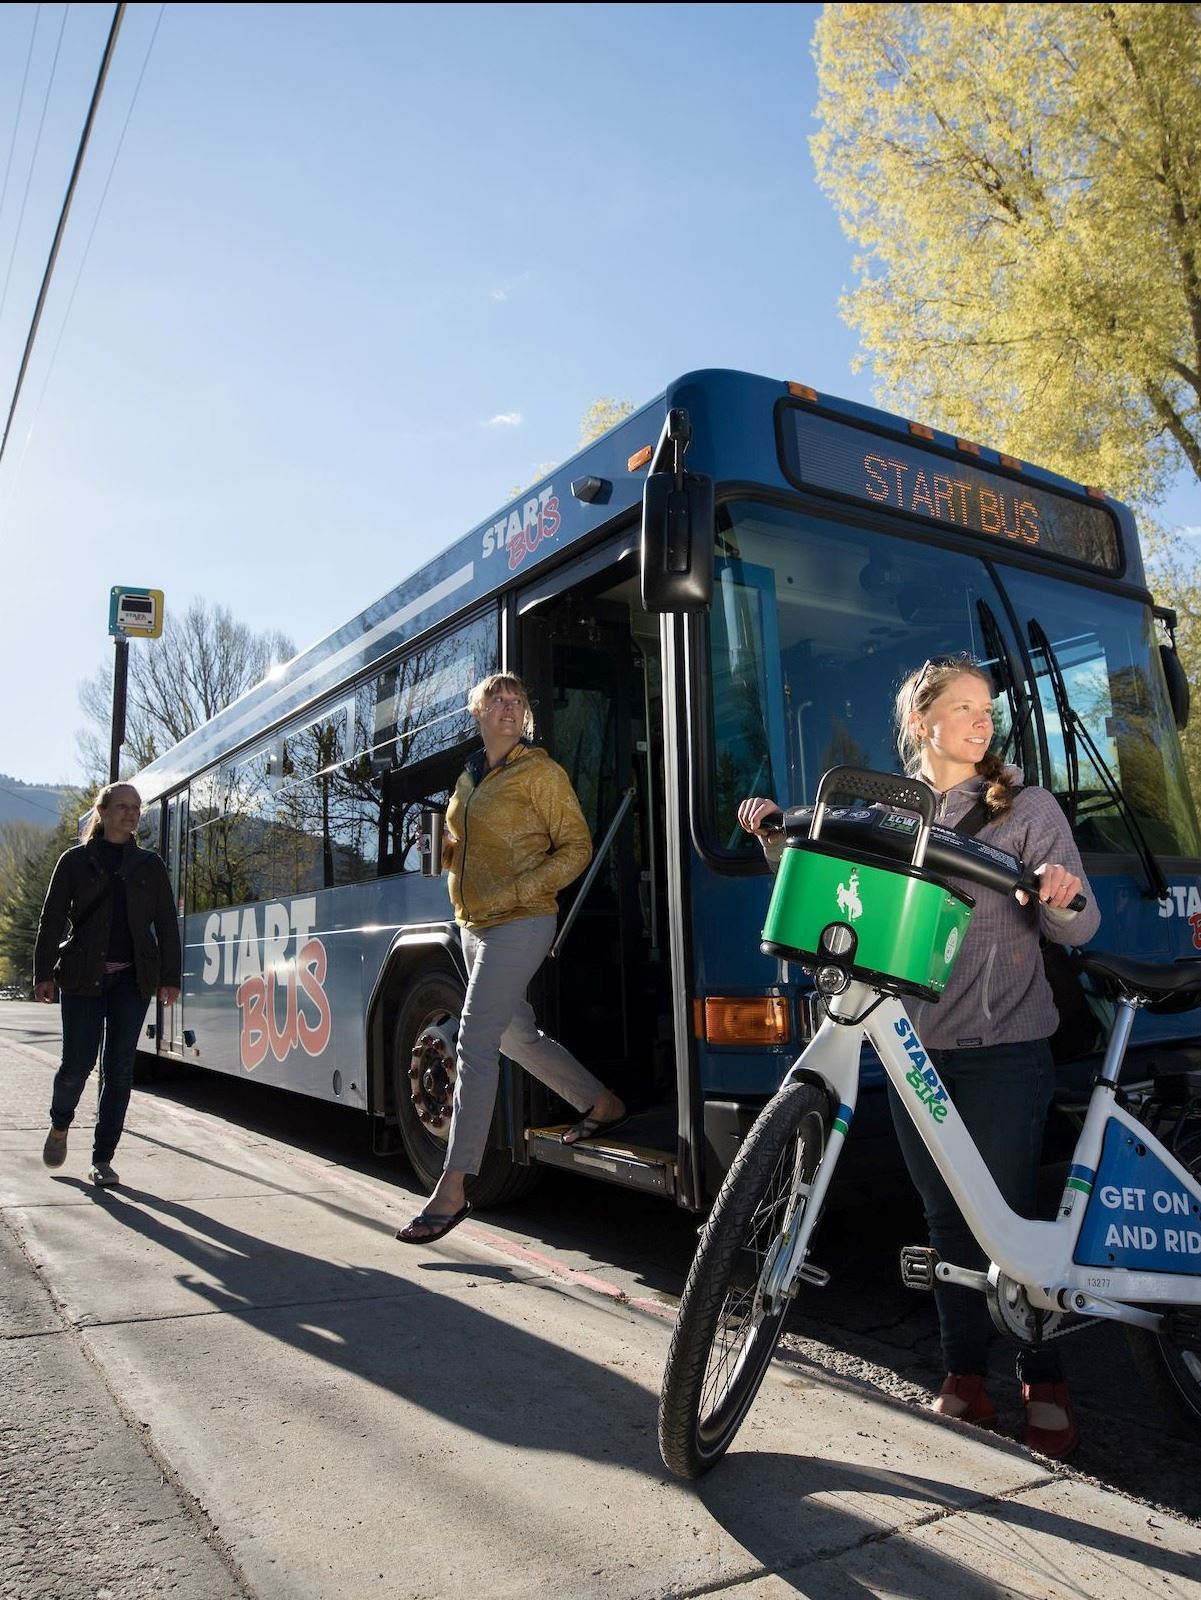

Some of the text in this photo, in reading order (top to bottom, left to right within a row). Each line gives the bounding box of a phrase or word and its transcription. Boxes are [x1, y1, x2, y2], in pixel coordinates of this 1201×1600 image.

[482, 485, 553, 559] START
[506, 496, 560, 570] BUS
[864, 453, 1040, 545] START BUS
[203, 897, 317, 986] START
[236, 937, 331, 1072] BUS
[894, 1018, 949, 1102] START
[1100, 1185, 1190, 1216] GET ON
[1104, 1223, 1158, 1250] AND
[1088, 1278, 1110, 1288] 13277
